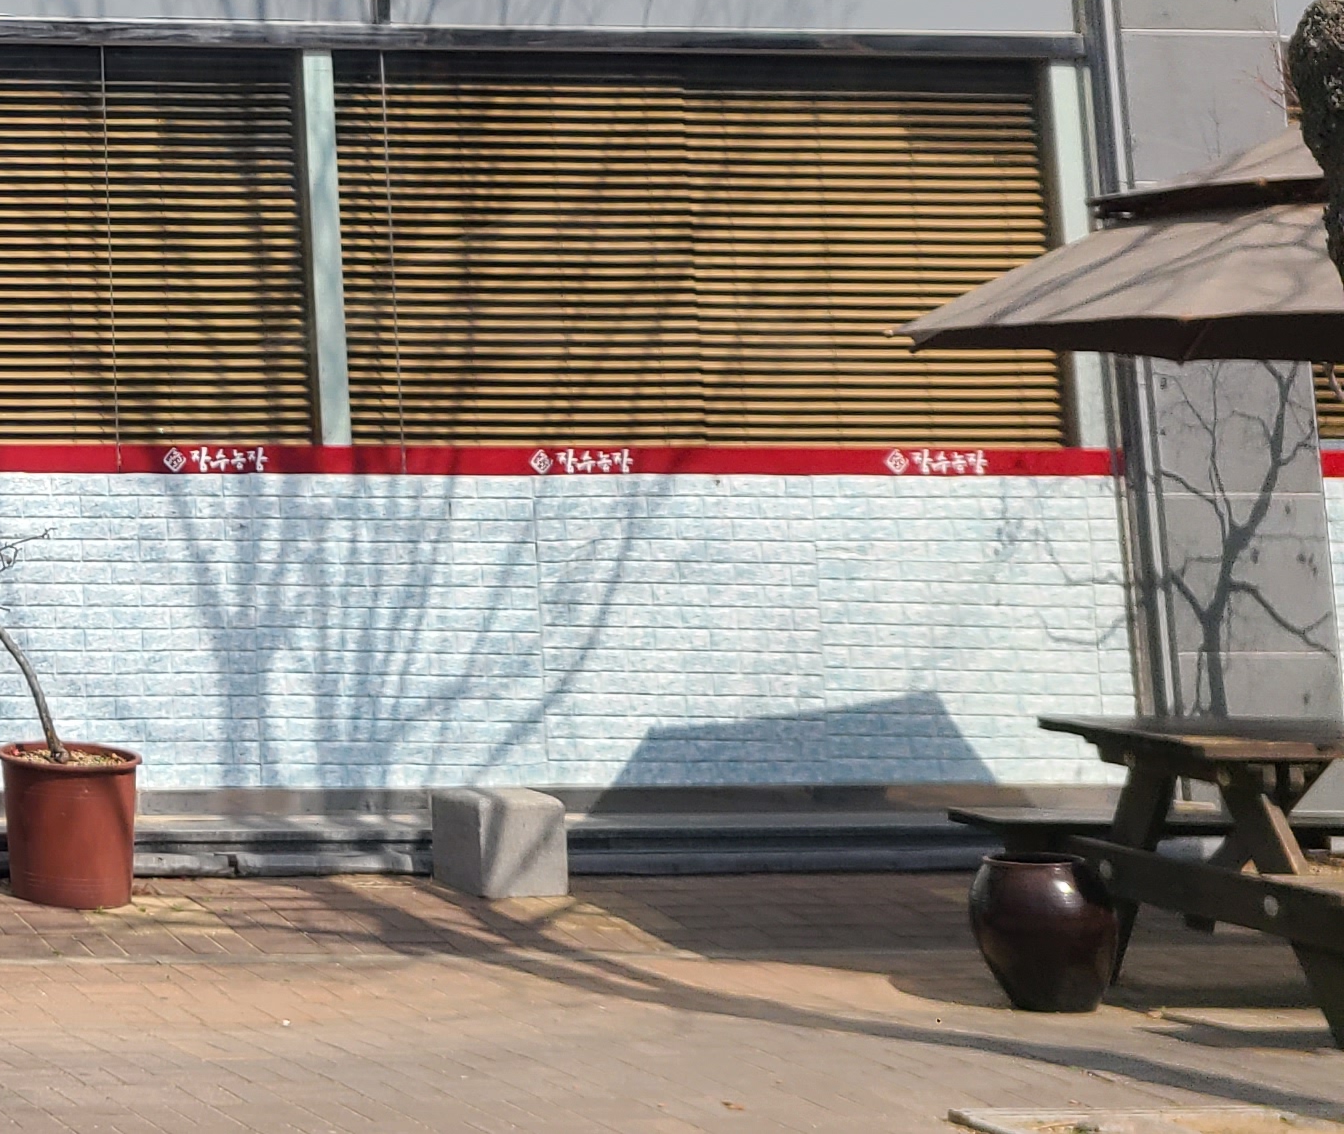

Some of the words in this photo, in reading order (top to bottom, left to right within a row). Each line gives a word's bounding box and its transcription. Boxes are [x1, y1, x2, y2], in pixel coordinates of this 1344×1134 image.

[189, 446, 269, 472] 장수농장
[555, 448, 634, 473] 장수농장
[910, 448, 989, 474] 장수농장
